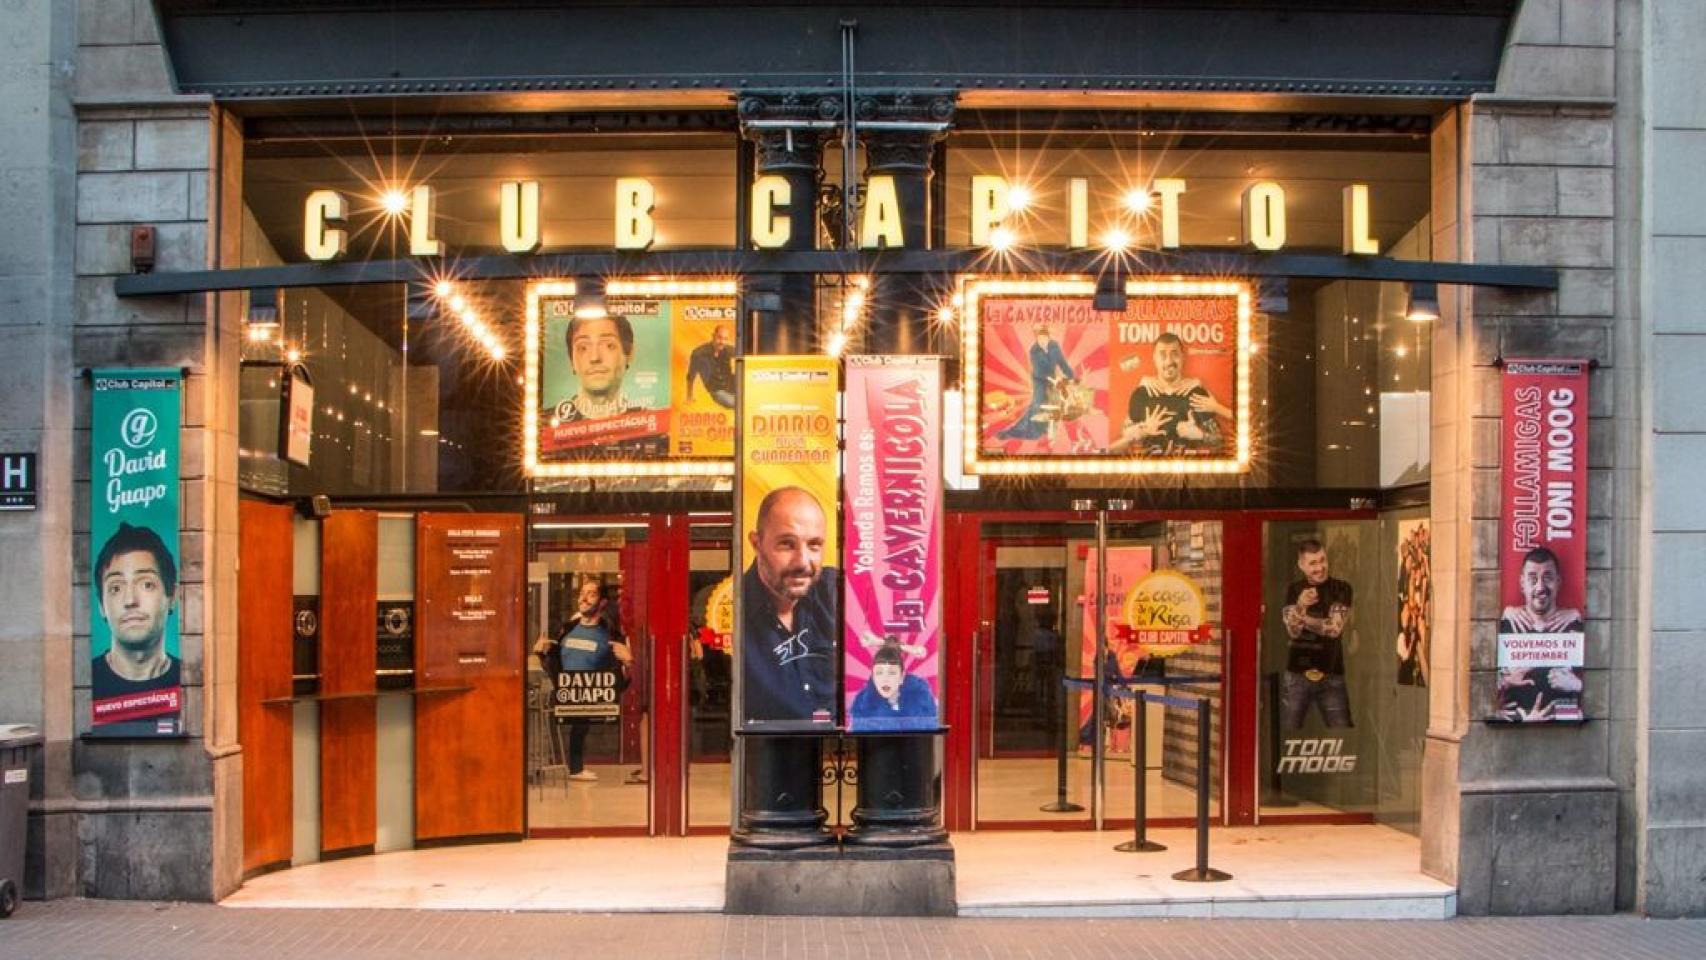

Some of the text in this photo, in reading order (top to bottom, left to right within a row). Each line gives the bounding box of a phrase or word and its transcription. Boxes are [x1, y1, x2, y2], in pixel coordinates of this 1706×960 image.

[304, 176, 1379, 261] CLUB CAPITOL
[1118, 322, 1224, 344] TONI MOOG
[751, 414, 830, 435] DIARIO
[5, 456, 27, 489] H
[103, 448, 166, 478] David
[1513, 385, 1542, 552] FOLLAMIGAS
[1546, 387, 1574, 541] TONI MOOG
[106, 478, 167, 513] Guapo
[854, 456, 874, 508] Ramos
[853, 512, 874, 574] Yolanda
[1504, 639, 1577, 649] VOLVEMOS EN
[1510, 651, 1569, 661] SEPTIEMBRE
[558, 672, 616, 688] DAVID
[1285, 738, 1344, 756] TONI
[1277, 755, 1357, 773] MOOG
